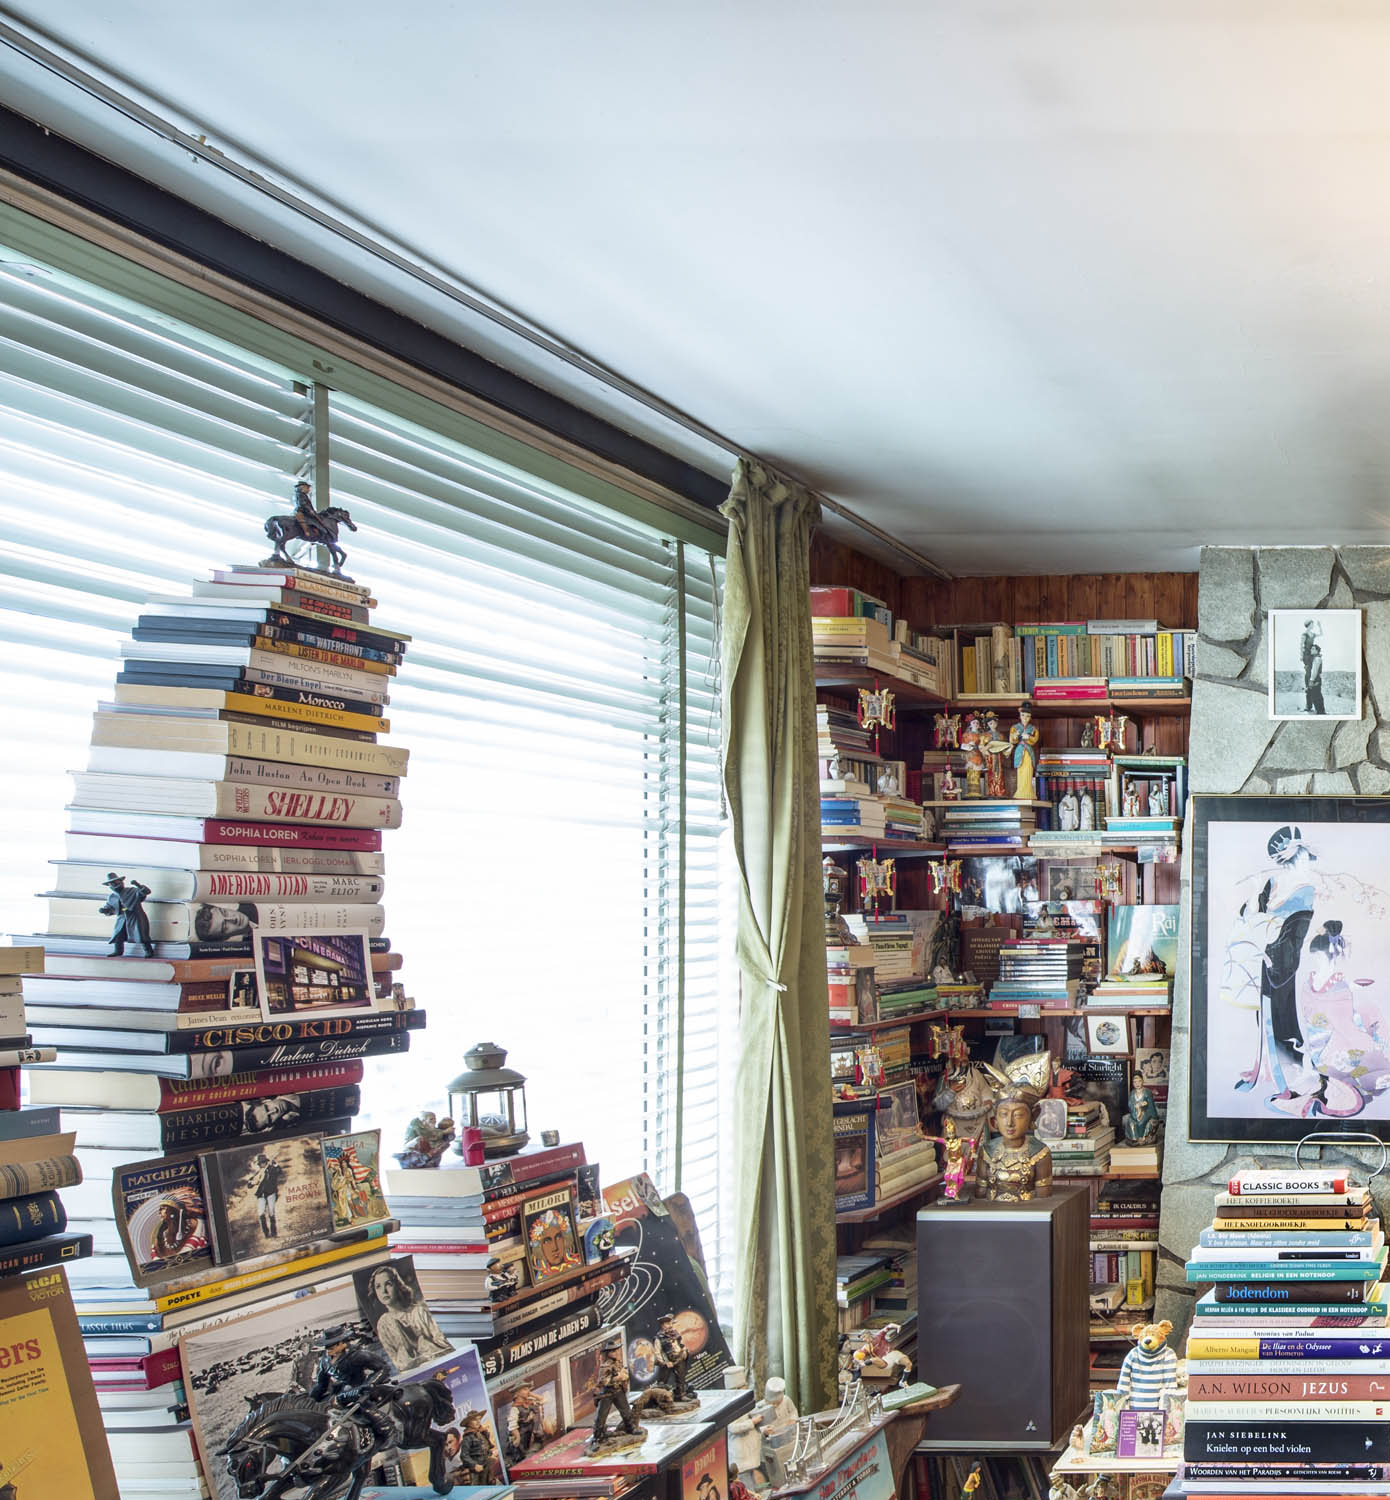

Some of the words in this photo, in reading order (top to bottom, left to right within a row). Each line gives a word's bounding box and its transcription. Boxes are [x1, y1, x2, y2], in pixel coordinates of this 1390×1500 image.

[317, 637, 363, 656] WATERFRONT
[299, 648, 319, 658] LISTEN
[320, 650, 329, 660] TO
[330, 652, 340, 663] ME
[299, 693, 345, 710] Morocco
[265, 703, 303, 716] MARLENE
[305, 709, 344, 721] DIETRICH
[228, 761, 251, 776] John
[256, 765, 290, 780] Huston
[299, 771, 313, 782] An
[318, 774, 341, 785] Open
[345, 776, 366, 788] Book
[264, 791, 356, 822] SHELLEY
[219, 827, 261, 838] SOPHIA
[263, 829, 298, 840] LOREN
[214, 854, 246, 862] SOPHIA
[248, 855, 277, 863] LOREN
[209, 874, 271, 896] AMERICAN
[276, 876, 308, 896] TITAN
[332, 878, 360, 886] MARC
[331, 887, 360, 896] ELIOT
[1151, 913, 1176, 936] Raj
[300, 937, 346, 965] CINERAMA
[187, 1015, 208, 1025] James
[210, 1013, 227, 1022] Dean
[202, 1024, 293, 1046] CISCO
[300, 1018, 352, 1036] KID
[260, 1045, 315, 1065] Marlene
[319, 1039, 371, 1056] Dietrich
[269, 1072, 300, 1083] SIMON
[166, 1109, 239, 1128] CHARLTON
[166, 1122, 238, 1143] HESTON
[287, 1183, 320, 1194] MARTY
[1243, 1181, 1282, 1190] CLASSIC
[285, 1190, 322, 1203] BROWN
[26, 1274, 61, 1290] RCA
[30, 1288, 64, 1302] VICTOR
[167, 1291, 200, 1306] POPEYE
[1226, 1286, 1289, 1298] Jodendom
[510, 1341, 533, 1363] FILMS
[534, 1333, 548, 1351] VAN
[548, 1329, 557, 1342] DE
[558, 1320, 579, 1340] JAREN
[579, 1315, 589, 1331] 50
[1198, 1383, 1226, 1394] A.N.
[1232, 1383, 1291, 1395] WILSON
[1302, 1382, 1349, 1396] JEZUS
[1207, 1444, 1238, 1452] Knielen
[1241, 1446, 1251, 1455] op
[1270, 1444, 1284, 1453] bed
[1287, 1444, 1311, 1453] violen
[542, 1468, 583, 1476] EXPRESS
[838, 1445, 877, 1486] Francisco
